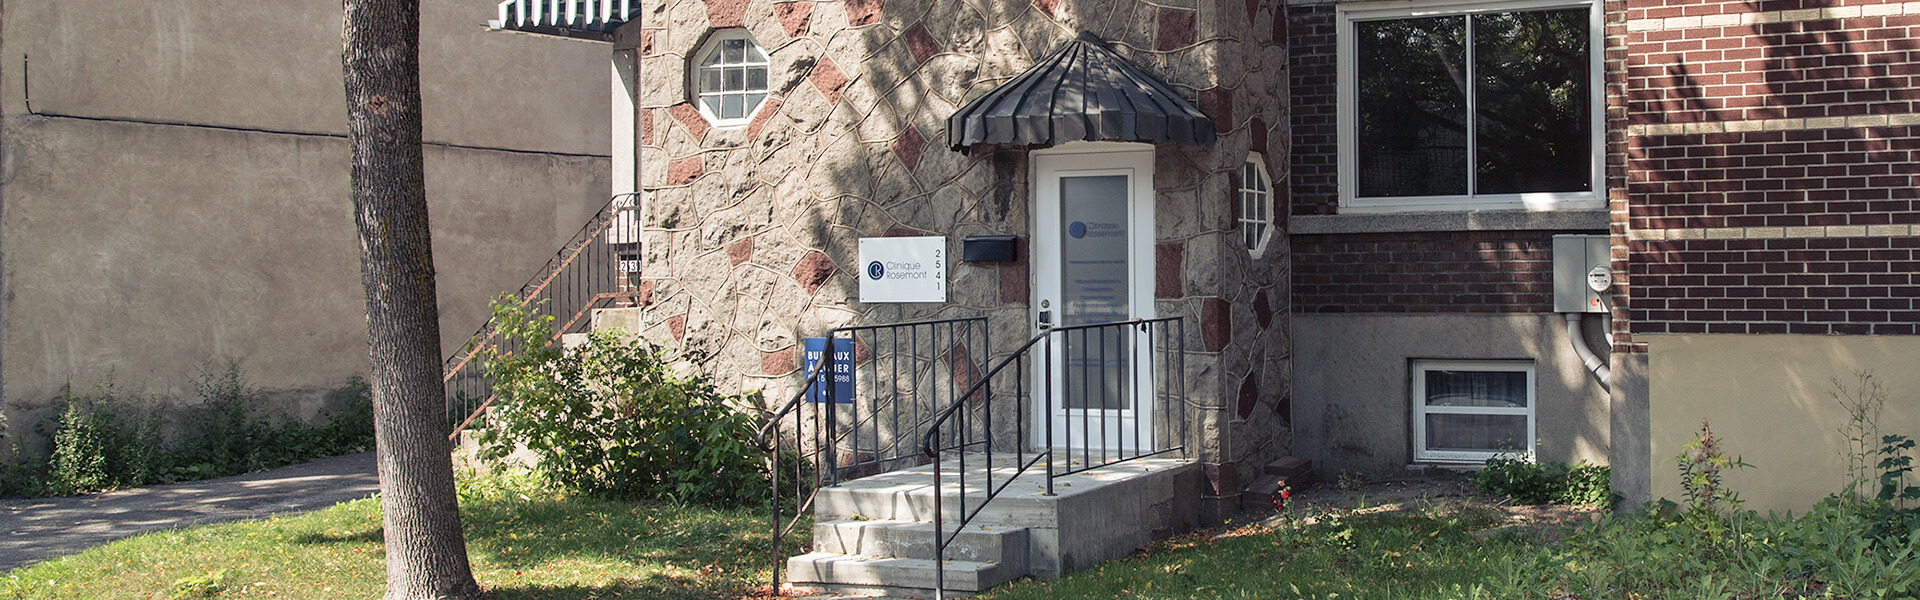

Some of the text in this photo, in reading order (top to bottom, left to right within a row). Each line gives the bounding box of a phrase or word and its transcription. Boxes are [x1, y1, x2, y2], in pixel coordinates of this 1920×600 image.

[886, 261, 920, 271] Clinique
[886, 271, 927, 279] Rosemont
[807, 351, 849, 360] BUUX
[807, 360, 814, 372] À
